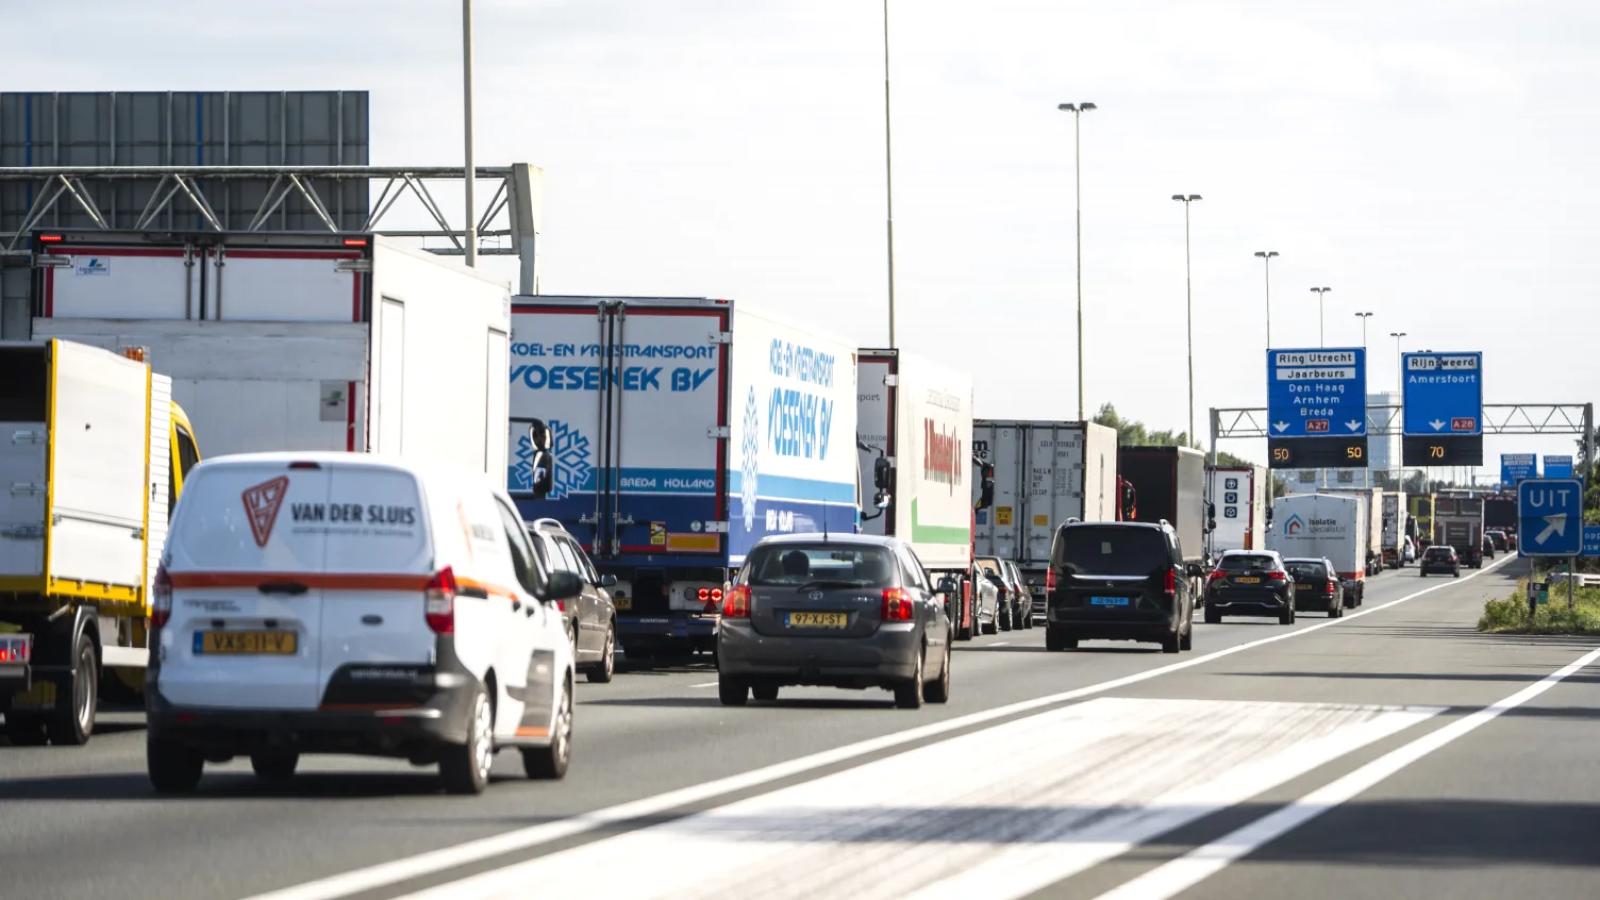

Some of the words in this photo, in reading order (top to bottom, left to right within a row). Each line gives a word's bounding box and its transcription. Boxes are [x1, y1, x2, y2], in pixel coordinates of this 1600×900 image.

[580, 344, 715, 359] VRSTRANSPORT
[1280, 354, 1305, 364] Ring
[1309, 353, 1353, 362] Utrecht
[510, 365, 663, 391] VOESENEK
[671, 368, 715, 392] BV
[1288, 370, 1345, 379] Jaarbeurs
[1409, 375, 1476, 384] Amersfoort
[1289, 384, 1311, 392] Den
[1315, 384, 1345, 394] Haag
[1293, 396, 1340, 404] Arnhem
[1300, 407, 1334, 416] Breda
[768, 387, 818, 458] VOESENEK
[819, 397, 834, 461] BV
[1308, 421, 1328, 430] A27
[1453, 420, 1474, 429] A28
[1274, 448, 1289, 460] 50
[1347, 446, 1362, 459] 50
[1429, 445, 1445, 459] 70
[620, 478, 656, 488] BREDA
[664, 478, 715, 489] HOLLAND
[1529, 489, 1571, 508] UIT
[291, 503, 325, 522] VAN
[328, 503, 364, 523] DER
[367, 505, 415, 526] SLUIS
[794, 614, 843, 624] 97-XJ-ST
